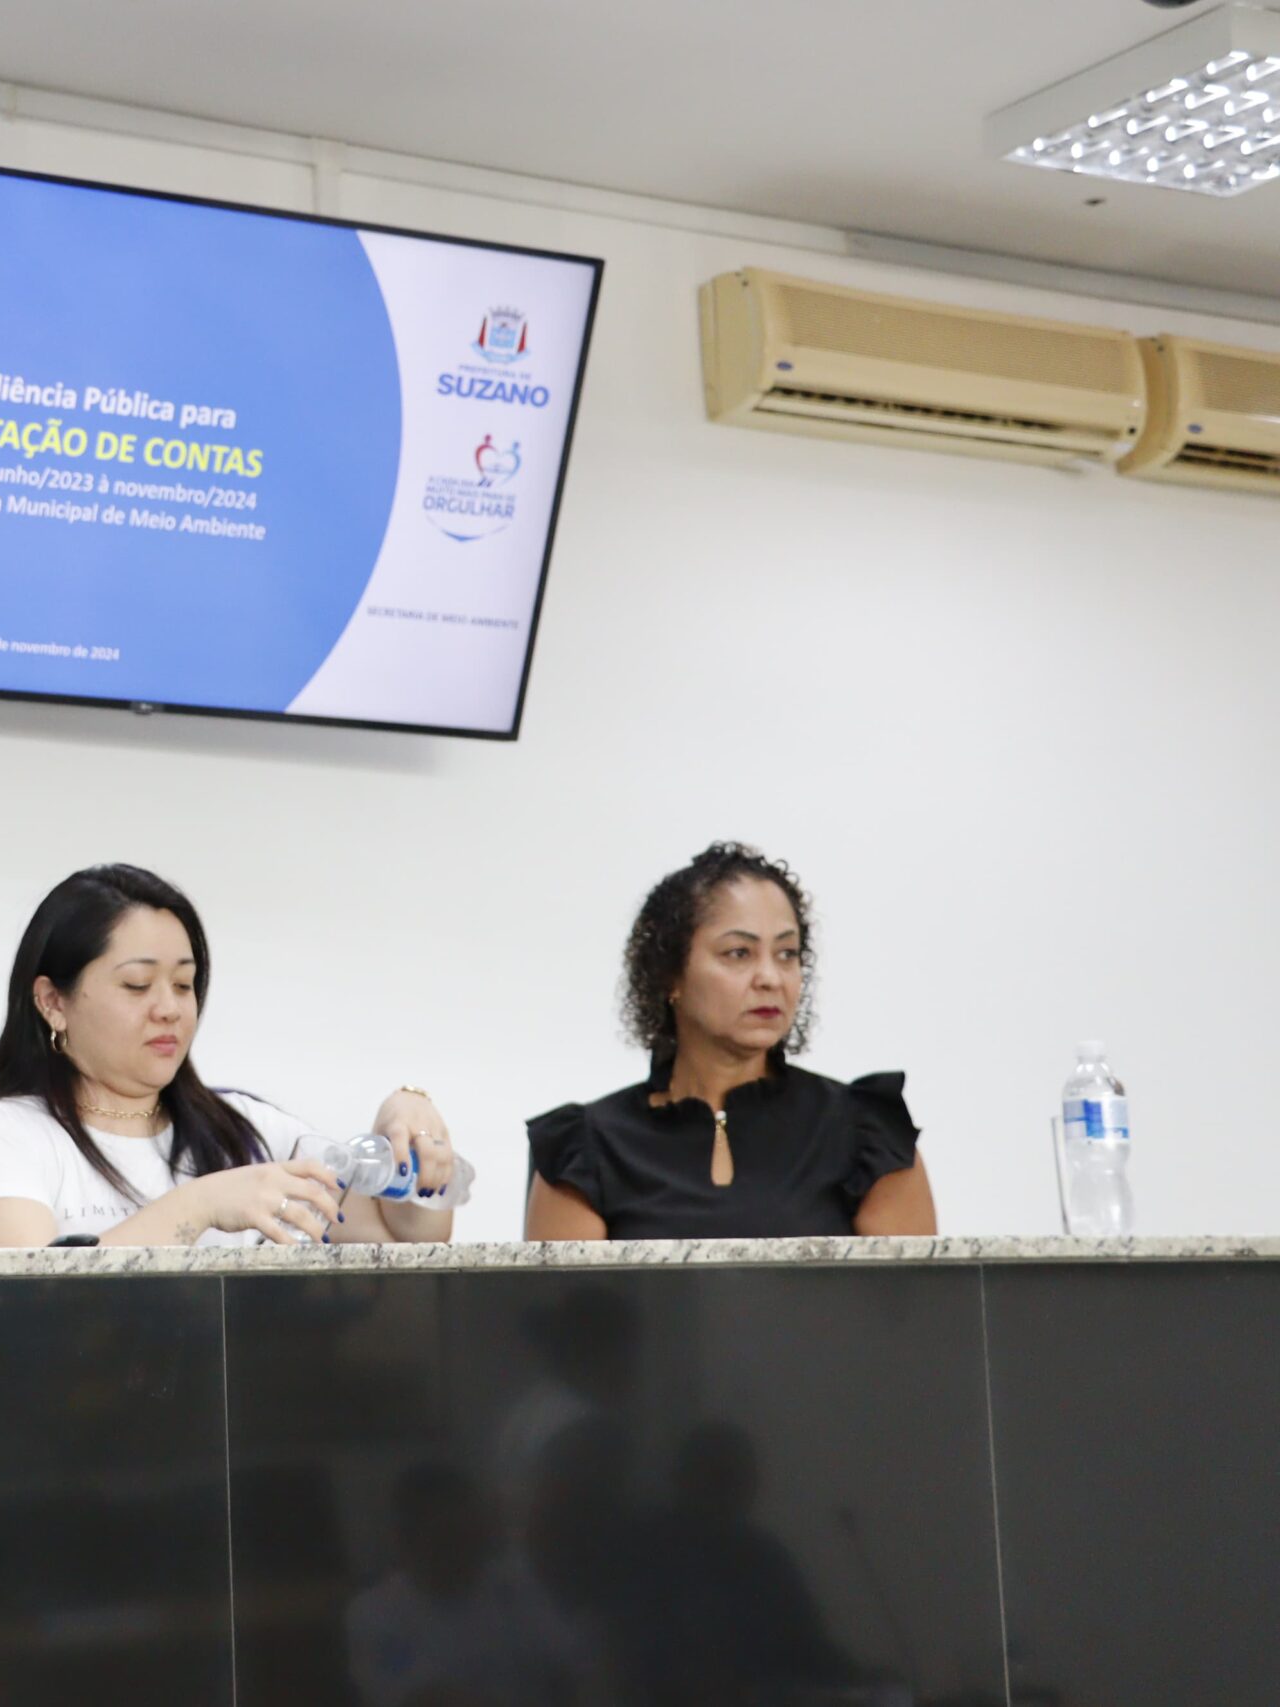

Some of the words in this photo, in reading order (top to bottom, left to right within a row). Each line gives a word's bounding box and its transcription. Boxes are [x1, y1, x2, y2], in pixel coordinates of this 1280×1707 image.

[83, 384, 174, 421] Pública
[179, 401, 237, 429] para
[437, 373, 549, 407] SUZANO
[96, 433, 137, 463] DE
[144, 438, 263, 478] CONTAS
[99, 476, 109, 494] à
[114, 479, 257, 510] novembro/2024
[423, 495, 515, 517] ORGULHAR
[7, 495, 97, 524] Municipal
[102, 504, 125, 526] de
[130, 509, 175, 531] Meio
[179, 515, 266, 541] Ambiente
[11, 641, 71, 657] novembro
[72, 645, 89, 659] de
[90, 646, 120, 661] 2024
